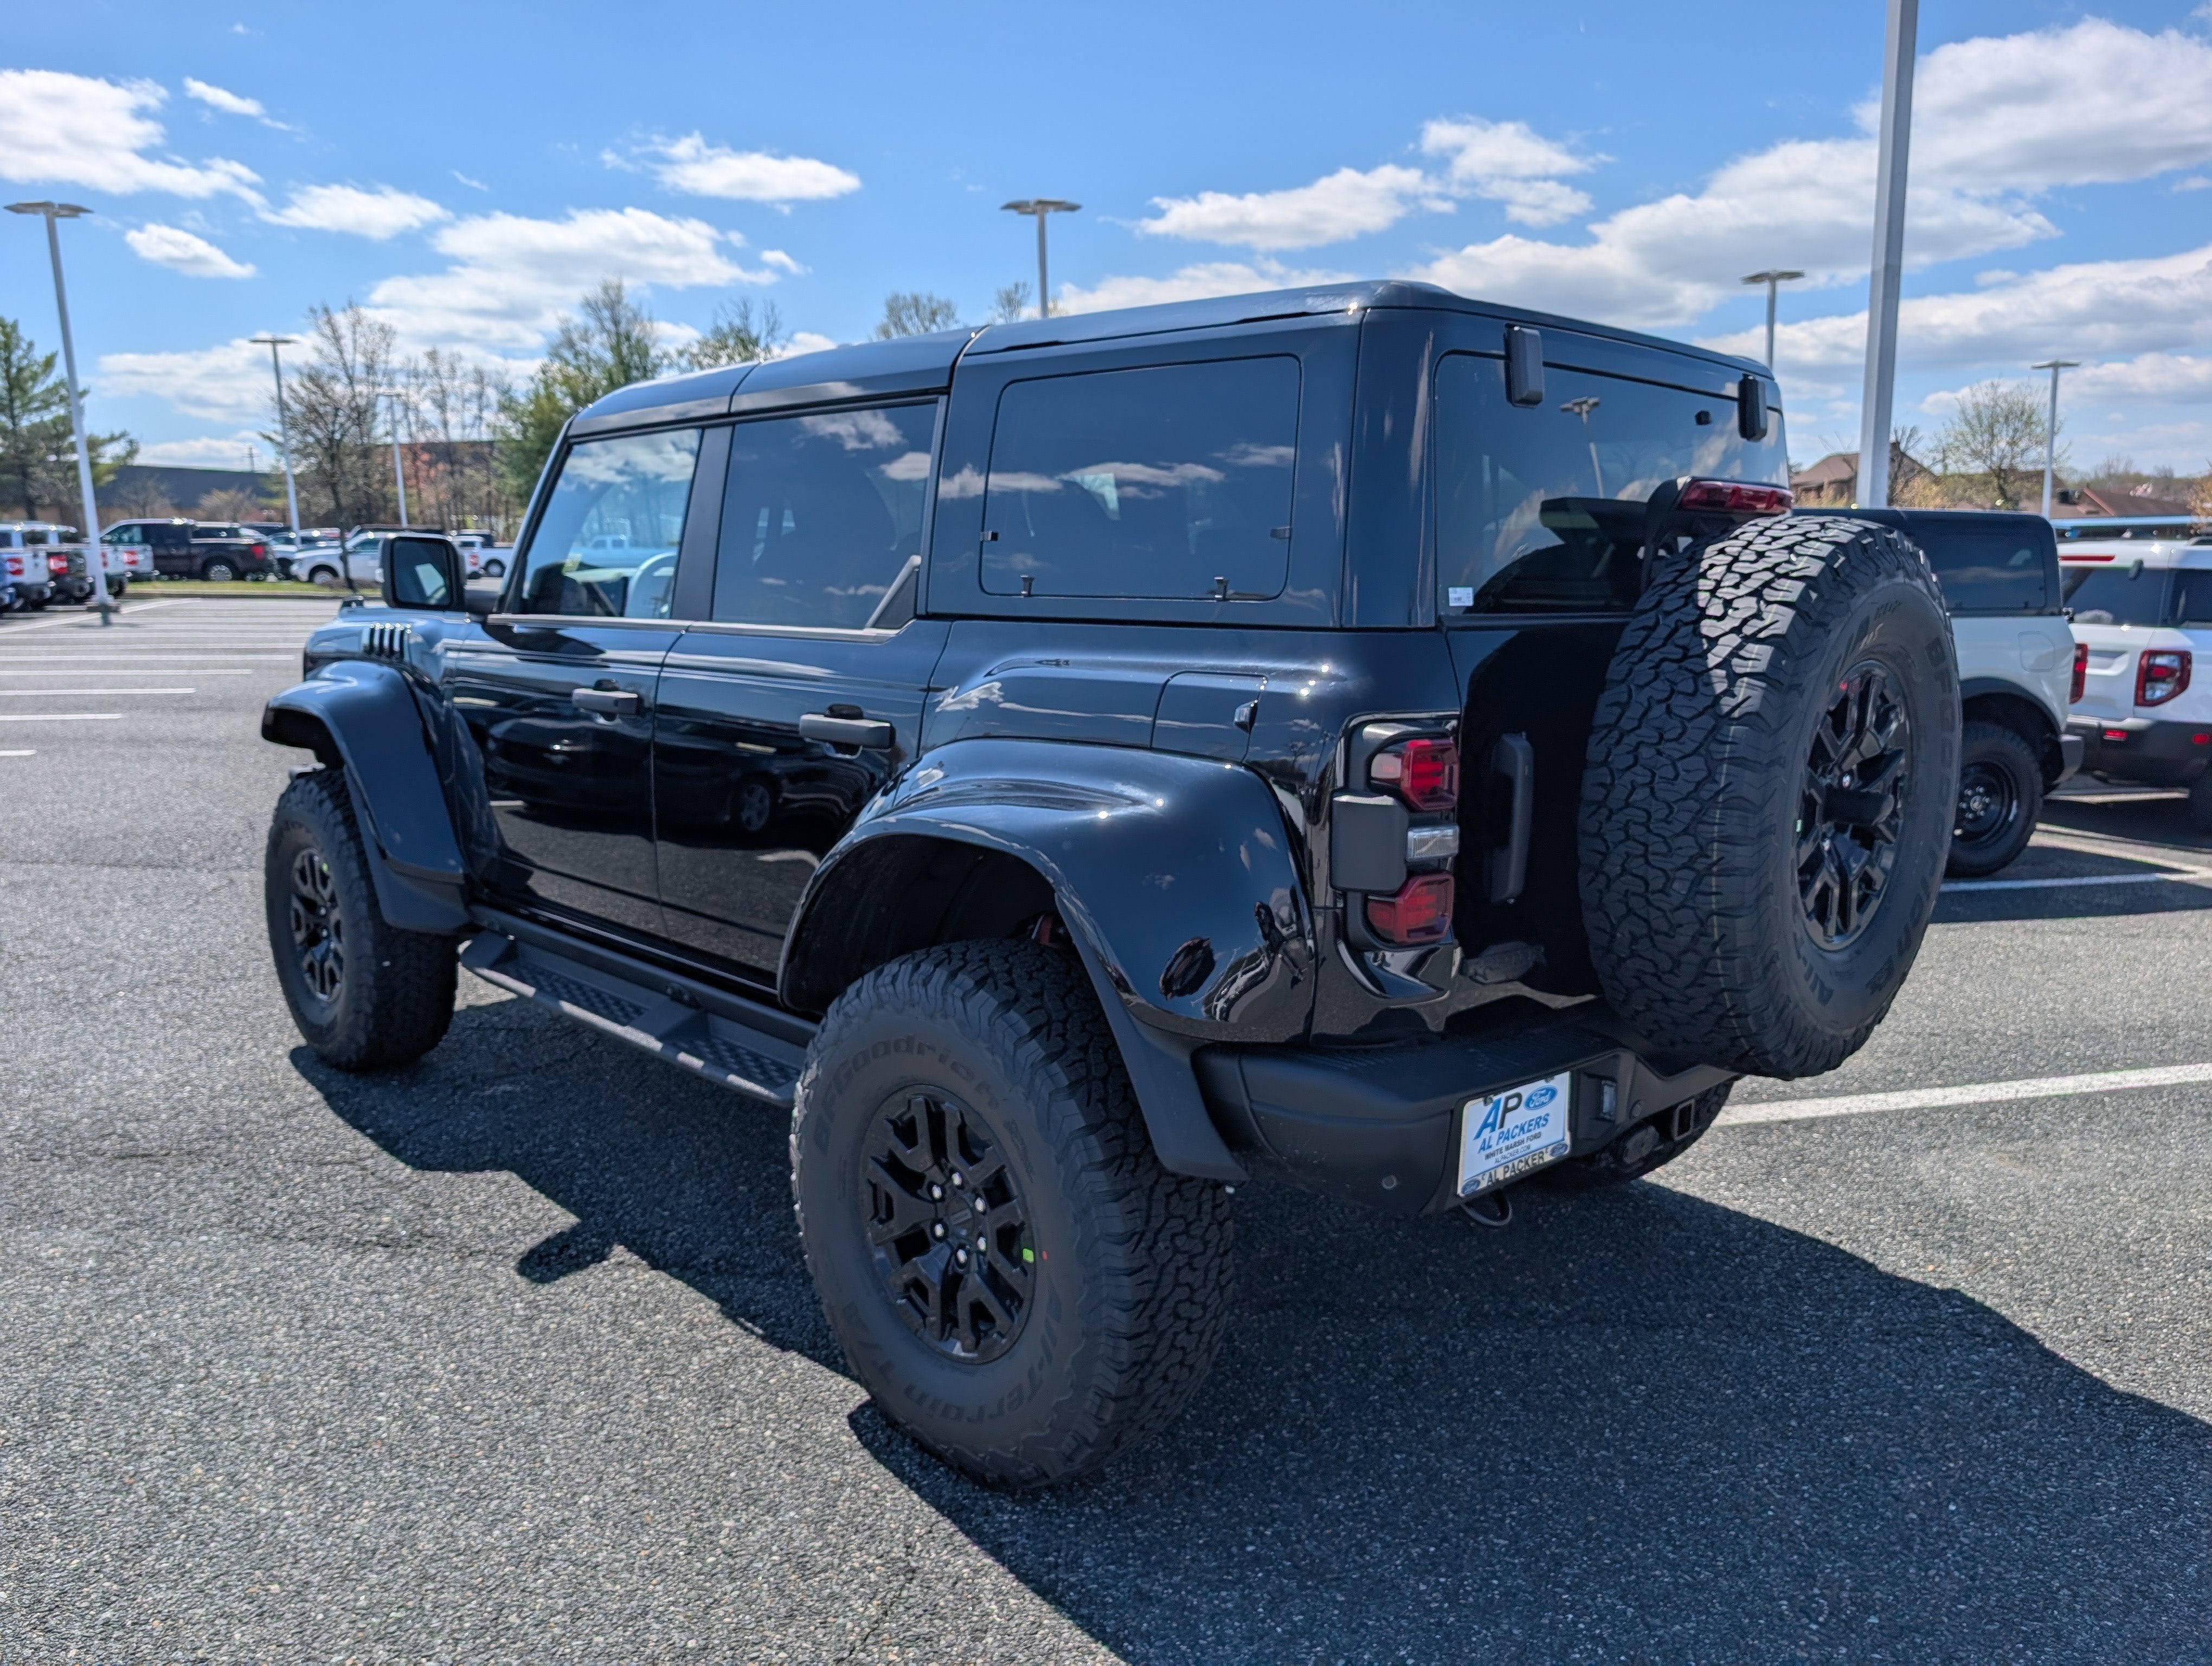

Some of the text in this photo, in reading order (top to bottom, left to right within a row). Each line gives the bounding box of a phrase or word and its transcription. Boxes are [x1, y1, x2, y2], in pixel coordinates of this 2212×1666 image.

[813, 1034, 999, 1154] BFGoodrich
[1528, 1087, 1553, 1108] Ford
[1473, 1092, 1522, 1140] AP
[1477, 1113, 1549, 1154] AL PACKERS
[1485, 1131, 1542, 1161] WHITE MARSH FORD
